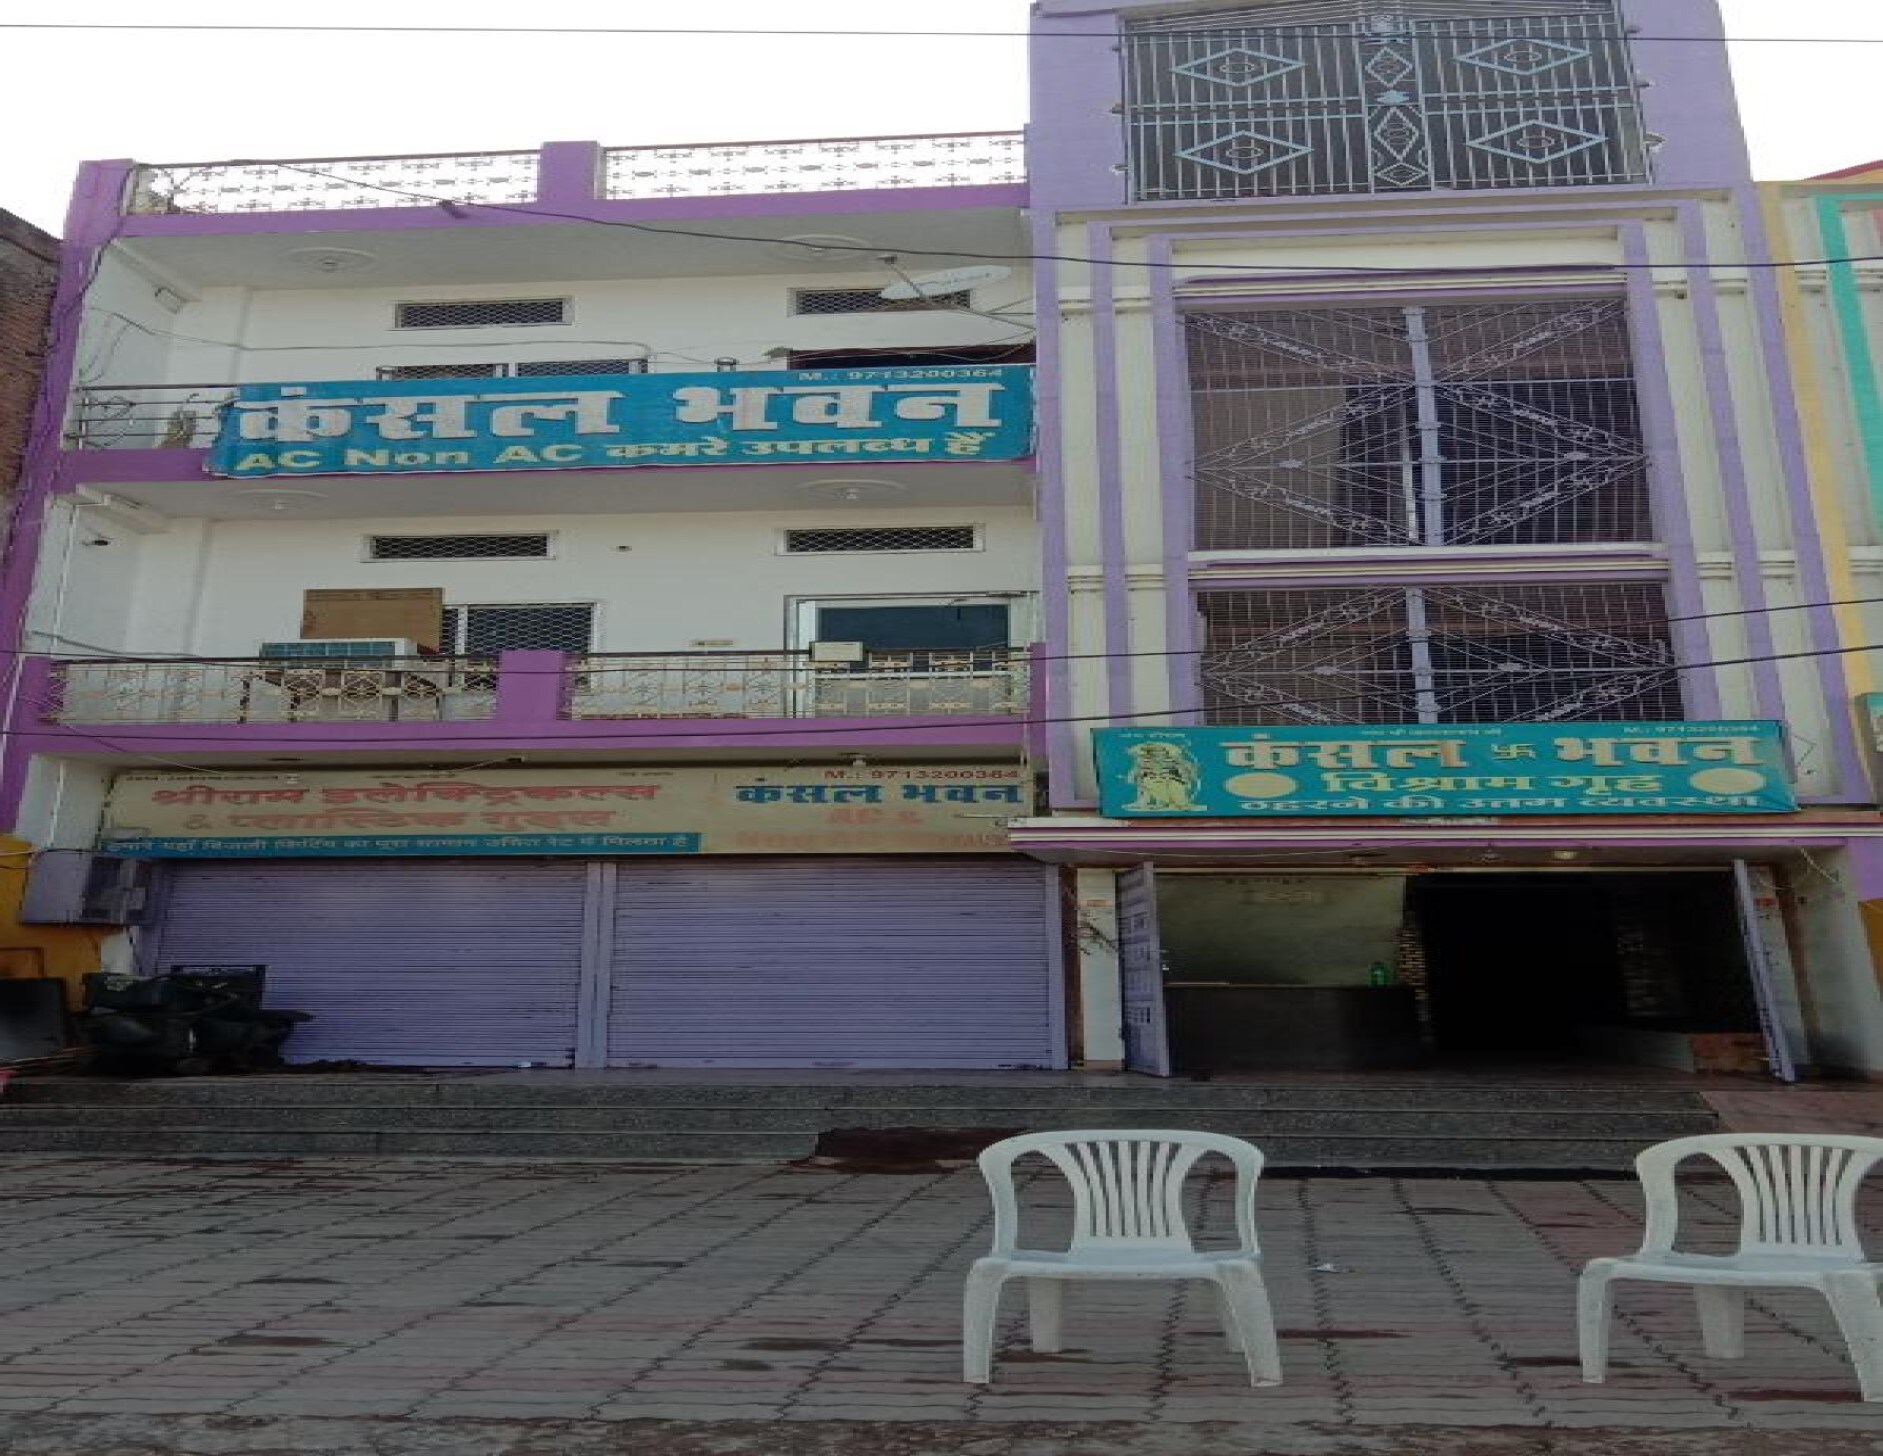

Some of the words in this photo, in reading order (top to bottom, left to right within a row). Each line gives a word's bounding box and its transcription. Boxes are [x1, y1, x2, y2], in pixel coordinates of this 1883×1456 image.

[233, 386, 624, 442] कंसल
[672, 382, 1006, 431] भवन
[235, 449, 321, 470] AC
[344, 447, 469, 466] Non
[494, 443, 583, 464] AC
[606, 436, 729, 459] कमरे
[741, 436, 935, 456] उपलब्ध
[1219, 733, 1469, 770] कंसल
[1554, 736, 1766, 768] भवन
[734, 777, 885, 804] कंसल
[901, 783, 1024, 804] भवन
[1321, 772, 1534, 792] विश्राम
[1548, 775, 1664, 796] गृह
[1383, 794, 1447, 810] की
[1460, 797, 1568, 808] उत्तम
